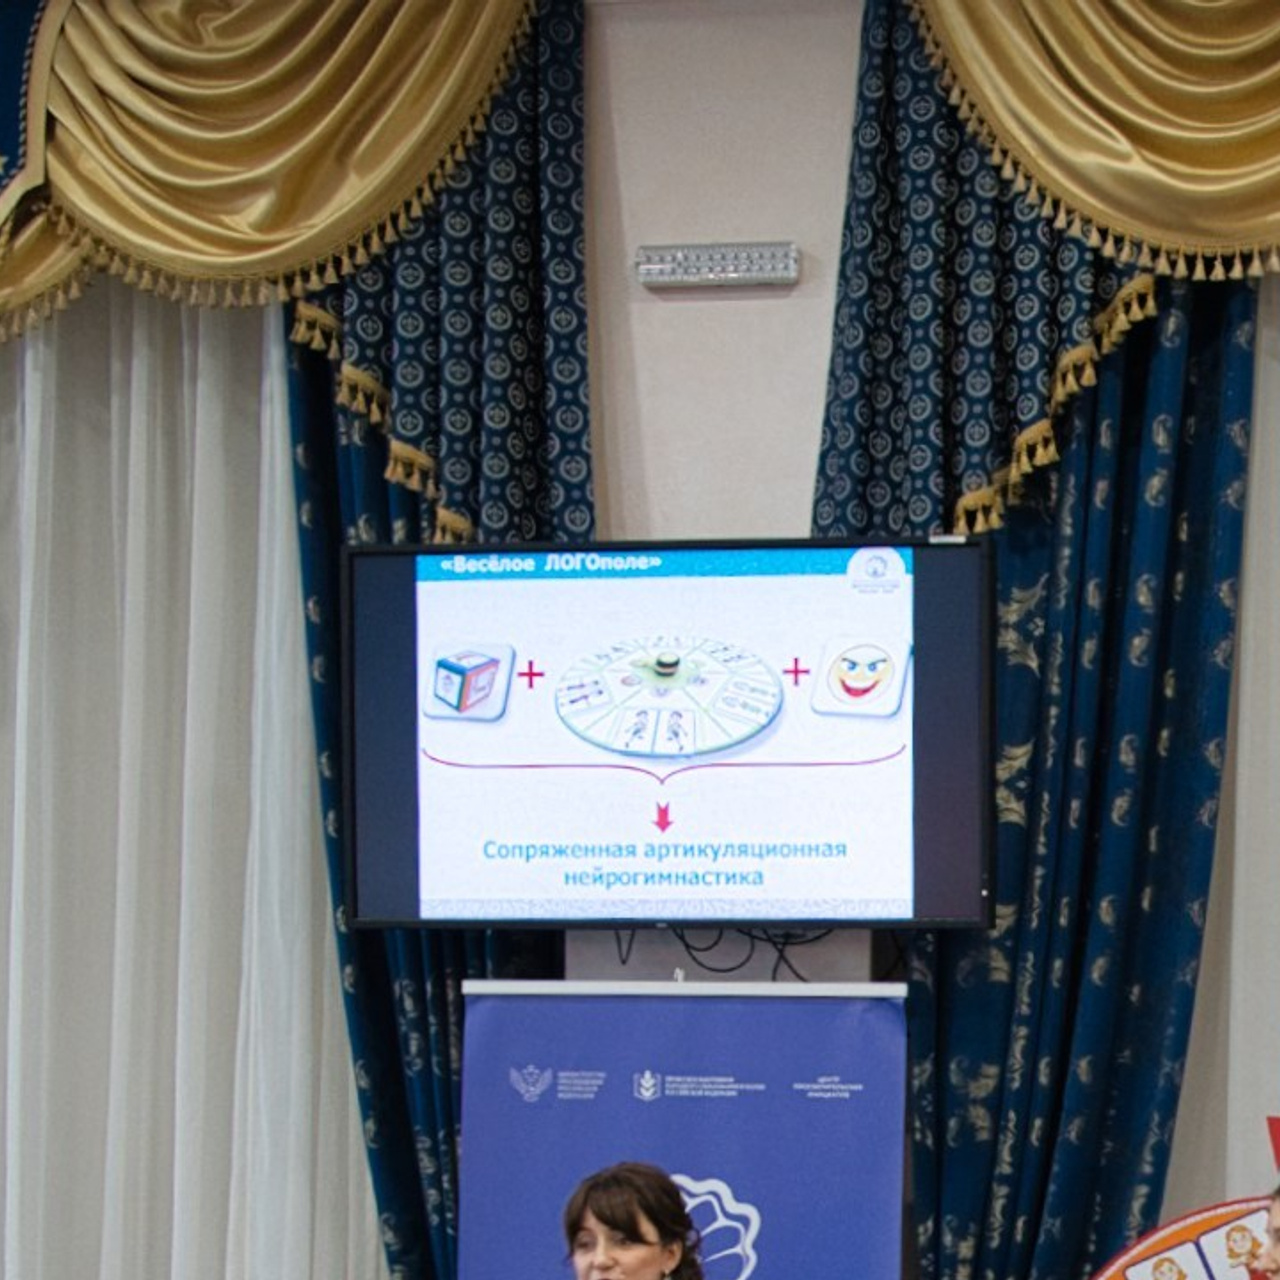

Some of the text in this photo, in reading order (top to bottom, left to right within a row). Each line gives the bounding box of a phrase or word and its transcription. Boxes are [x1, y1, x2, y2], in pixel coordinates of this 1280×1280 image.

[440, 552, 662, 573] «Весёлое ЛОГОполе»
[483, 839, 847, 862] Сопряженная артикуляционная
[564, 866, 764, 888] нейрогимнастика
